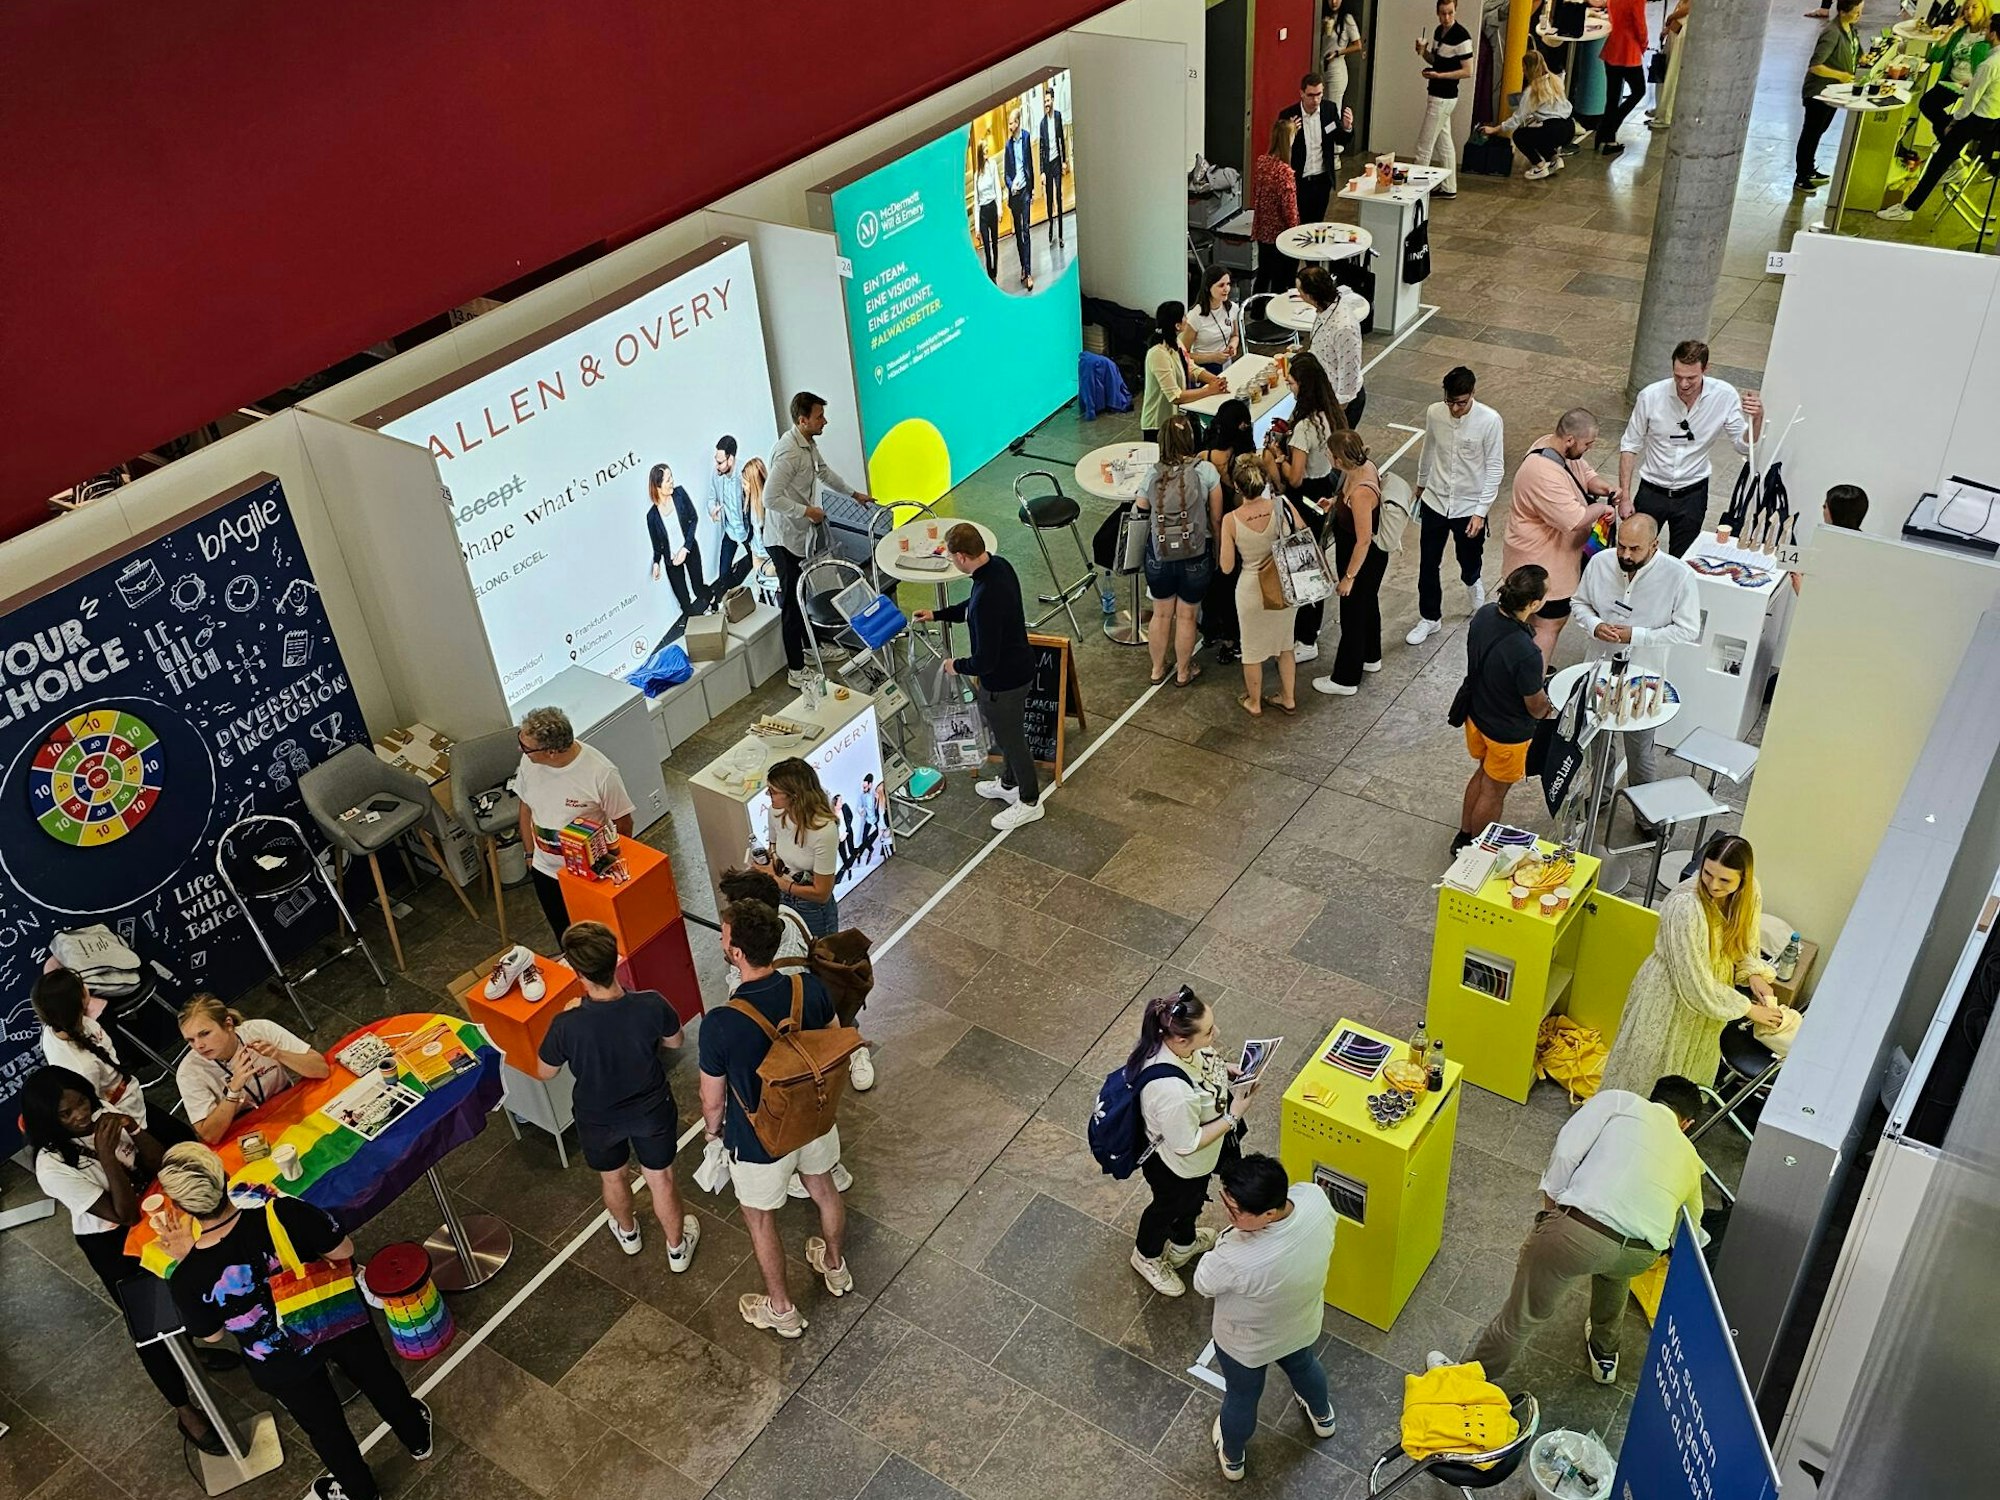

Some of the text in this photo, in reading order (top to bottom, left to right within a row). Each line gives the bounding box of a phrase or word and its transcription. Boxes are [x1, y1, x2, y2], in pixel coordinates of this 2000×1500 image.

[1188, 69, 1197, 78] 23
[841, 261, 851, 272] 24
[1769, 256, 1784, 268] 13
[863, 261, 908, 295] EIN TEAM.
[866, 273, 921, 314] EINE VISION.
[868, 284, 934, 333] EINE ZUKUNFT.
[870, 298, 943, 351] #ALWAYSBETTER.
[426, 278, 733, 461] ALLEN & OVERY
[454, 473, 527, 528] ccept
[523, 478, 590, 526] what's
[595, 449, 642, 487] next.
[197, 499, 282, 562] bAgile
[512, 550, 550, 575] EXCEL.
[1779, 550, 1799, 564] 14
[574, 593, 639, 638] Frankfurt am Main
[156, 636, 198, 673] GAL
[578, 628, 613, 655] München
[165, 648, 222, 696] TECH
[502, 652, 545, 685] Düsseldorf
[508, 674, 544, 701] Hamburg
[215, 665, 326, 748] DIVERSITY
[87, 718, 100, 732] 10
[126, 726, 141, 741] 10
[218, 673, 348, 768] & INCLUSION
[47, 743, 63, 758] 10
[90, 740, 101, 750] 40
[115, 744, 127, 755] 50
[824, 719, 869, 763] OVERY
[66, 755, 77, 767] 30
[127, 765, 138, 776] 20
[145, 759, 159, 774] 10
[34, 784, 51, 799] 10
[57, 782, 69, 793] 20
[120, 790, 131, 802] 50
[70, 803, 81, 813] 30
[96, 806, 107, 817] 40
[131, 800, 146, 814] 10
[55, 817, 71, 832] 10
[95, 824, 110, 838] 10
[173, 873, 217, 904] Life
[181, 888, 228, 921] with
[185, 904, 241, 941] Bake
[1661, 1343, 1681, 1399] dich
[1668, 1315, 1717, 1468] Wir suchen
[1656, 1362, 1702, 1500] wie du bist
